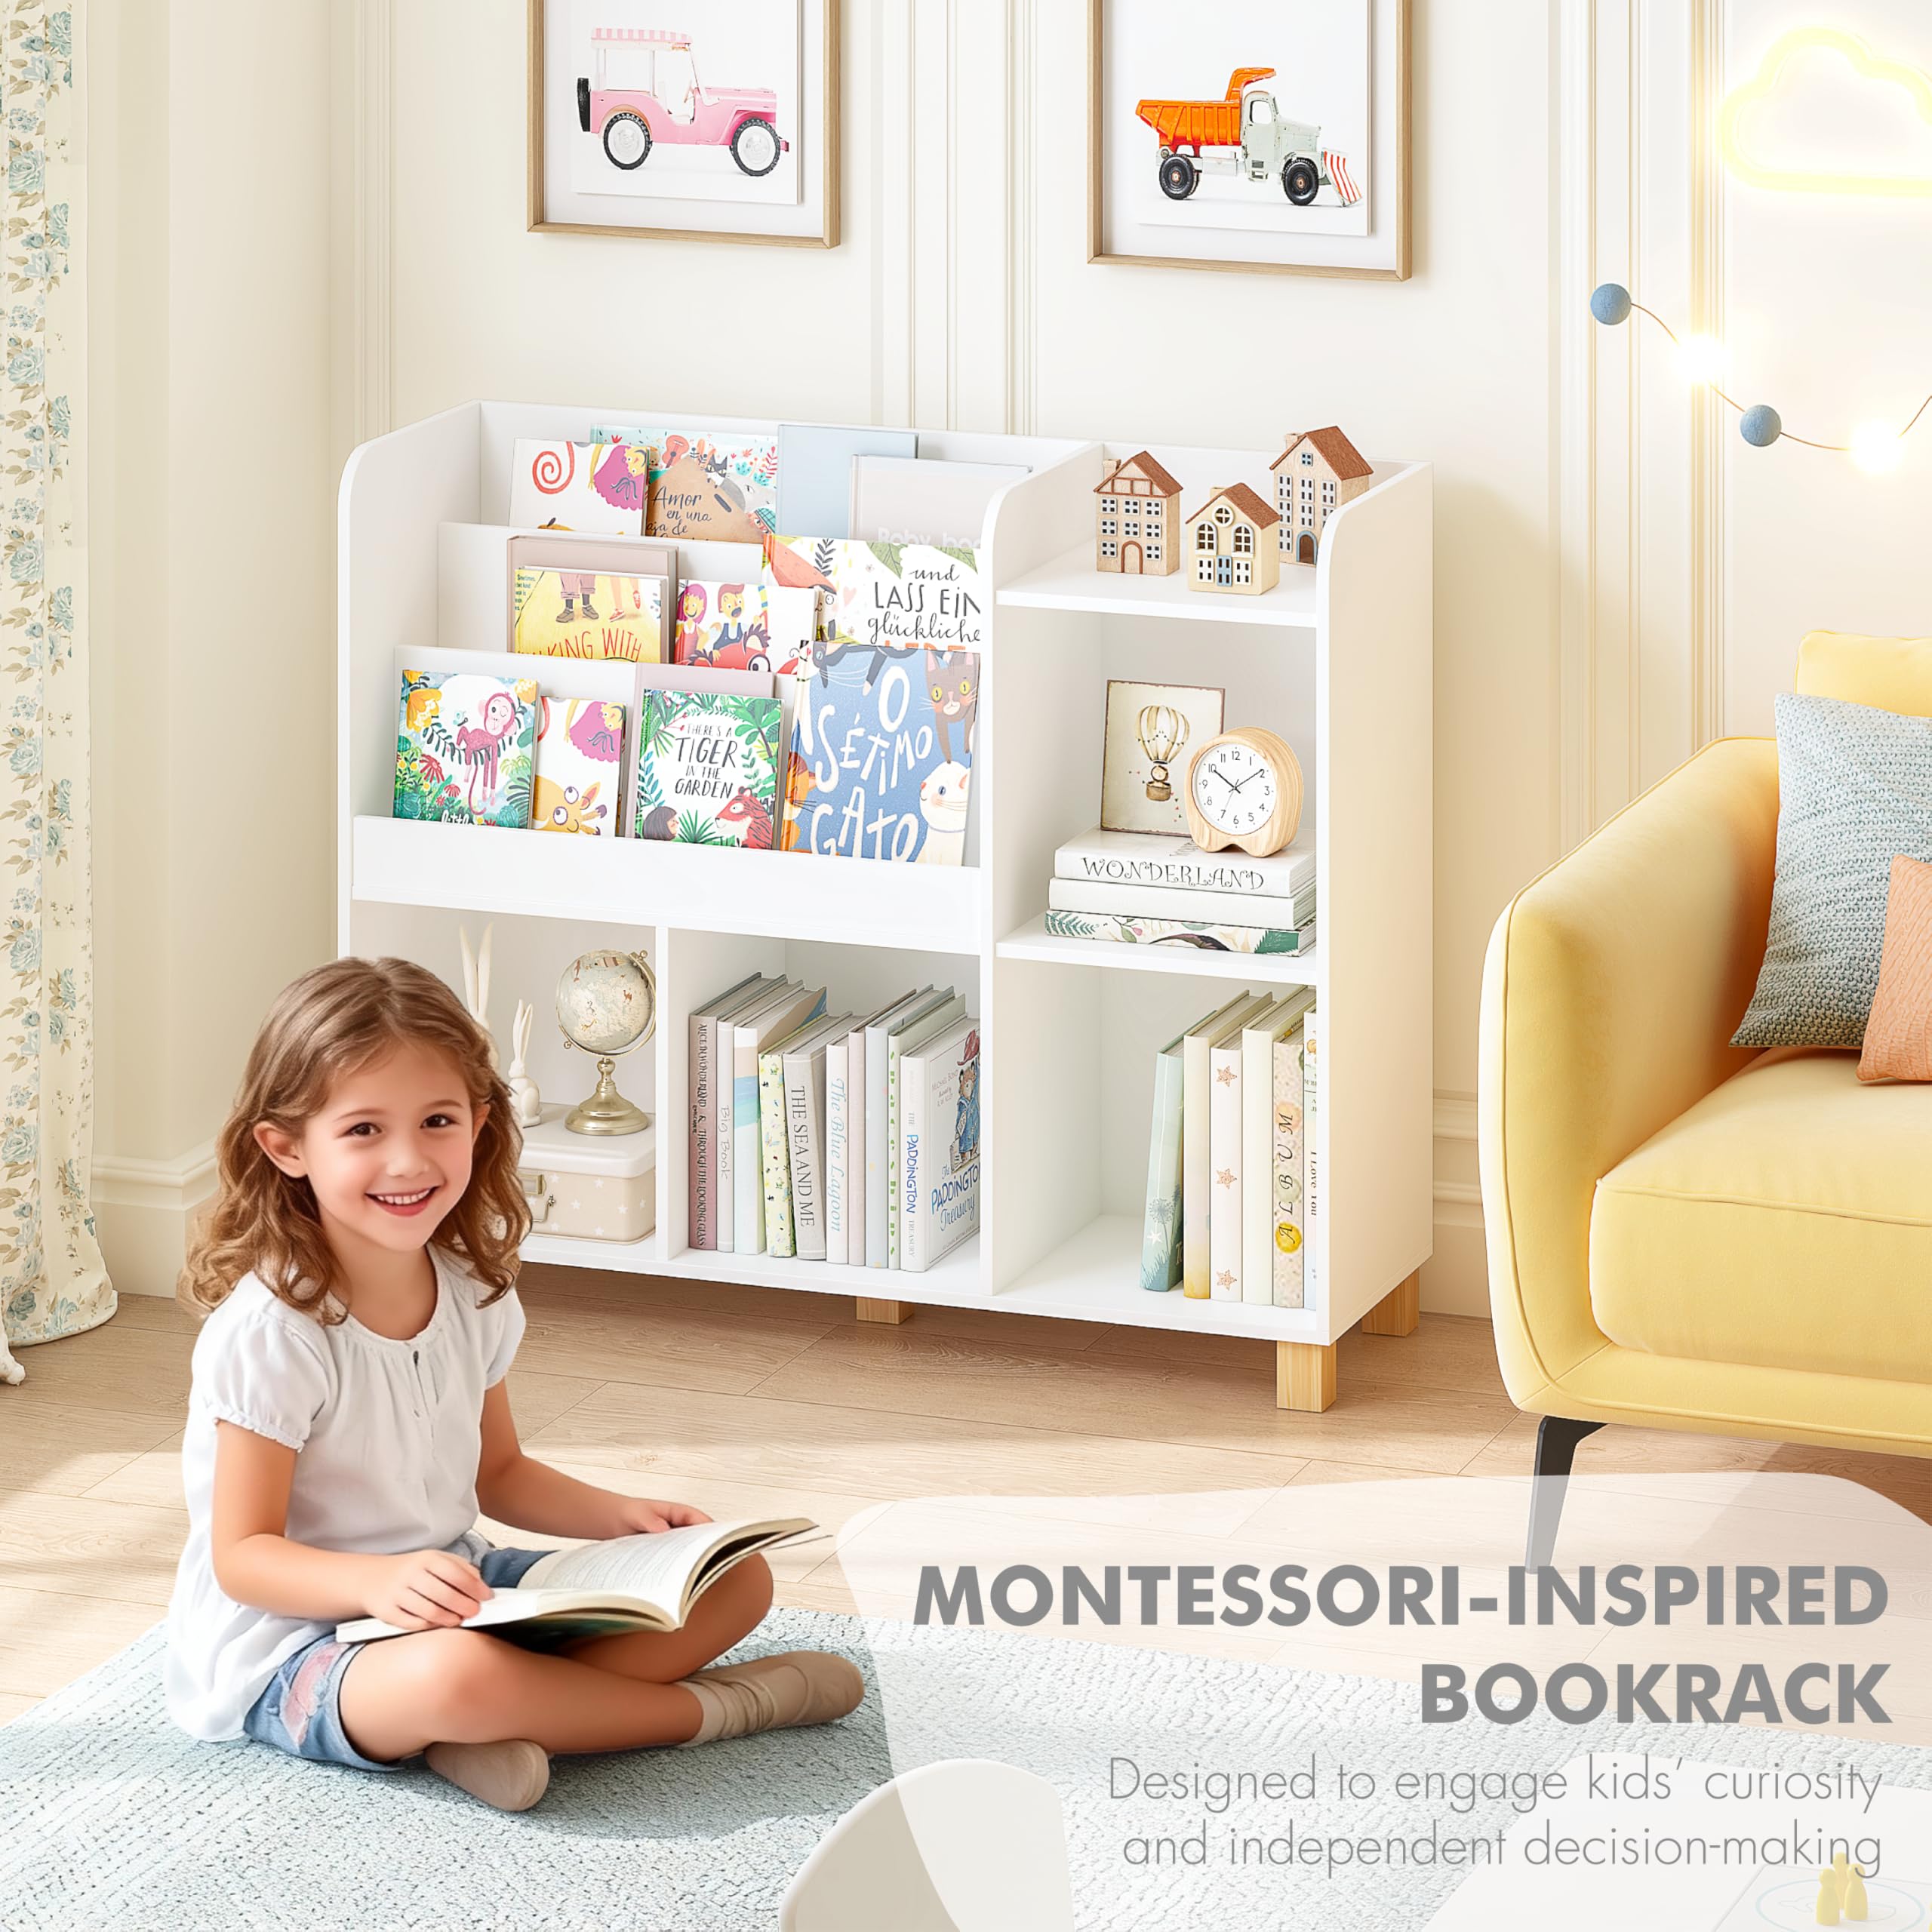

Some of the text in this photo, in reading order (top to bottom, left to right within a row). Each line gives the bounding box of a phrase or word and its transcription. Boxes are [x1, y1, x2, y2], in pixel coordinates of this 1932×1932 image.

[653, 486, 702, 509] Amor
[667, 509, 712, 521] en una
[672, 519, 688, 535] de
[908, 565, 960, 581] und
[875, 582, 924, 613] LASS
[602, 627, 641, 662] WITH
[878, 666, 910, 733] O
[675, 737, 737, 768] TIGER
[1220, 753, 1226, 763] 11
[1232, 750, 1241, 761] 12
[685, 765, 721, 780] IN THE
[1208, 763, 1217, 774] 10
[1259, 768, 1265, 778] 2
[675, 778, 733, 798] GARDEN
[1201, 780, 1208, 789] 9
[1264, 786, 1270, 795] 3
[1207, 796, 1212, 805] 8
[1259, 803, 1265, 811] 4
[1220, 809, 1226, 819] 7
[1233, 815, 1239, 824] 6
[1248, 812, 1254, 822] 5
[811, 786, 919, 862] GATO
[1081, 857, 1264, 890] WONDERLAND
[718, 1105, 731, 1180] Big Book
[791, 1085, 815, 1227] THE SEA AND ME
[828, 1078, 847, 1232] The Blue Lagoon
[697, 1171, 707, 1185] THE
[1278, 1113, 1295, 1244] ALBUM
[697, 1186, 707, 1223] LOOKING
[940, 1194, 975, 1231] Treasury
[697, 1223, 707, 1245] GLASS
